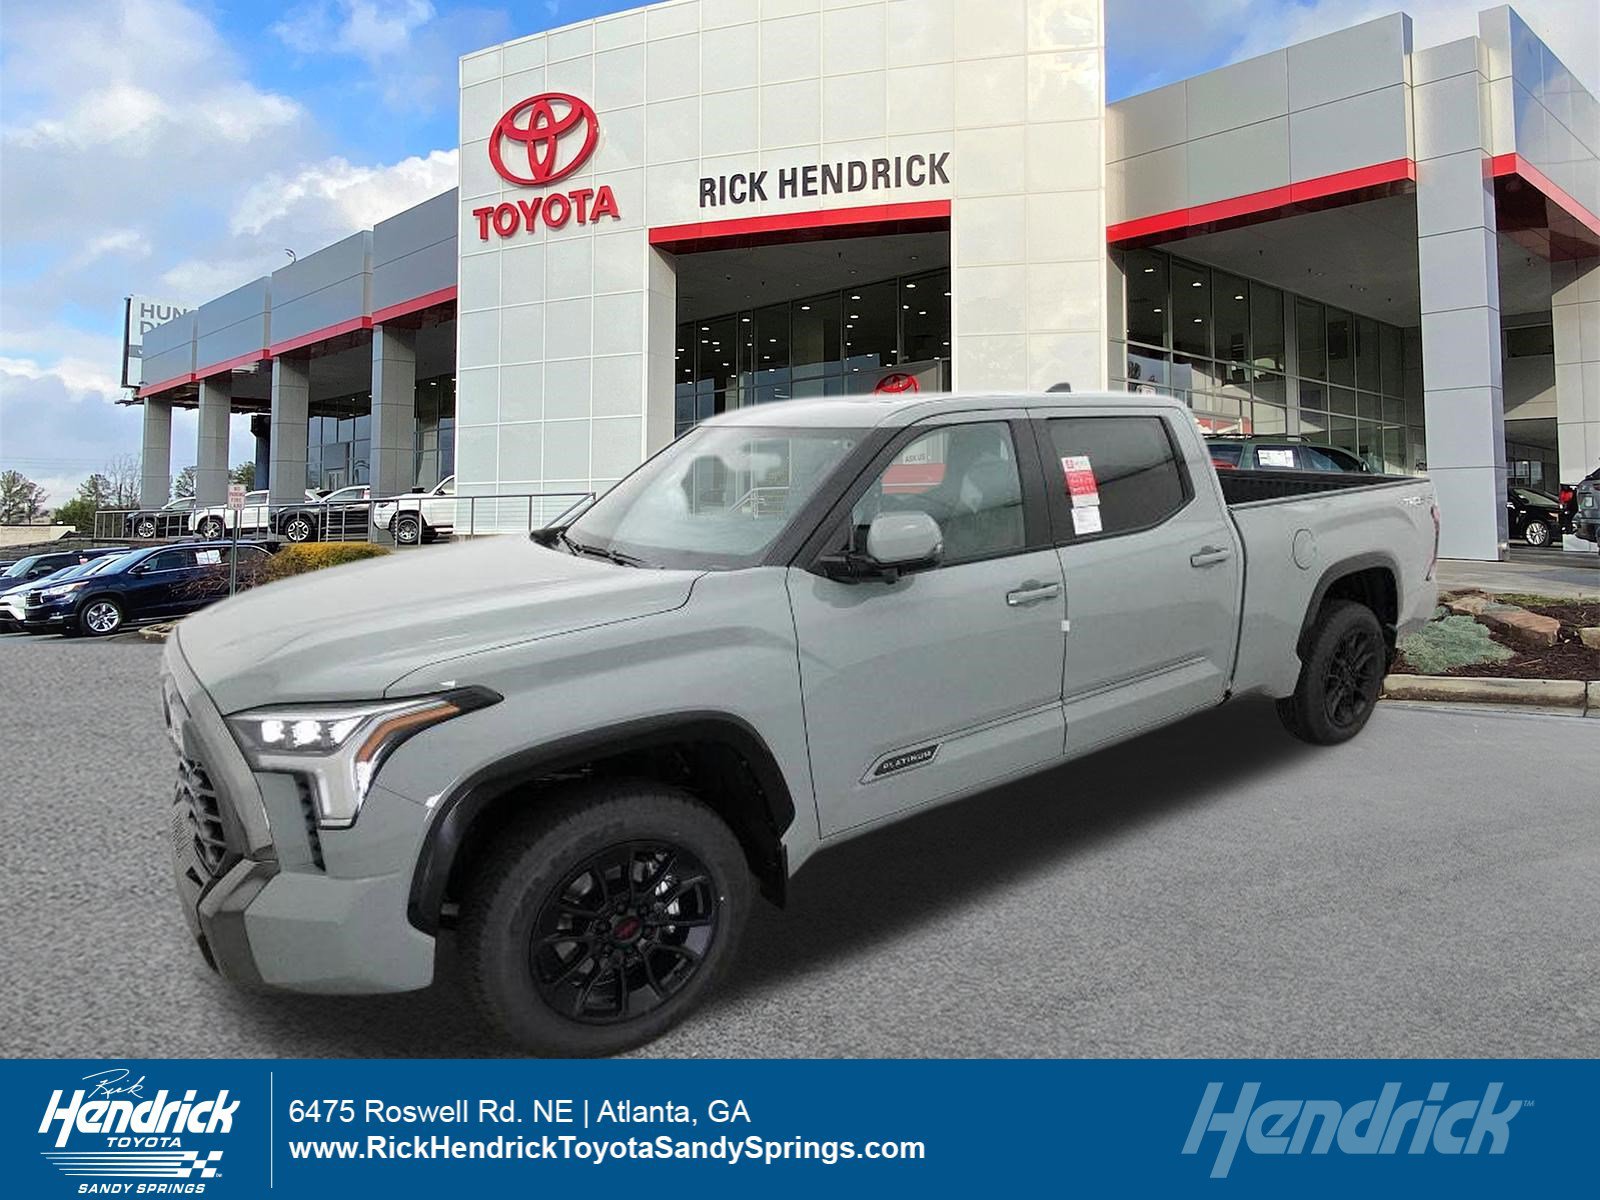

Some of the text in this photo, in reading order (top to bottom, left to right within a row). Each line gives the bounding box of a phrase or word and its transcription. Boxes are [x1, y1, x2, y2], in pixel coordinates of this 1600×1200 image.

[699, 152, 950, 208] RICK HENDRICK
[473, 185, 620, 241] TOYOTA
